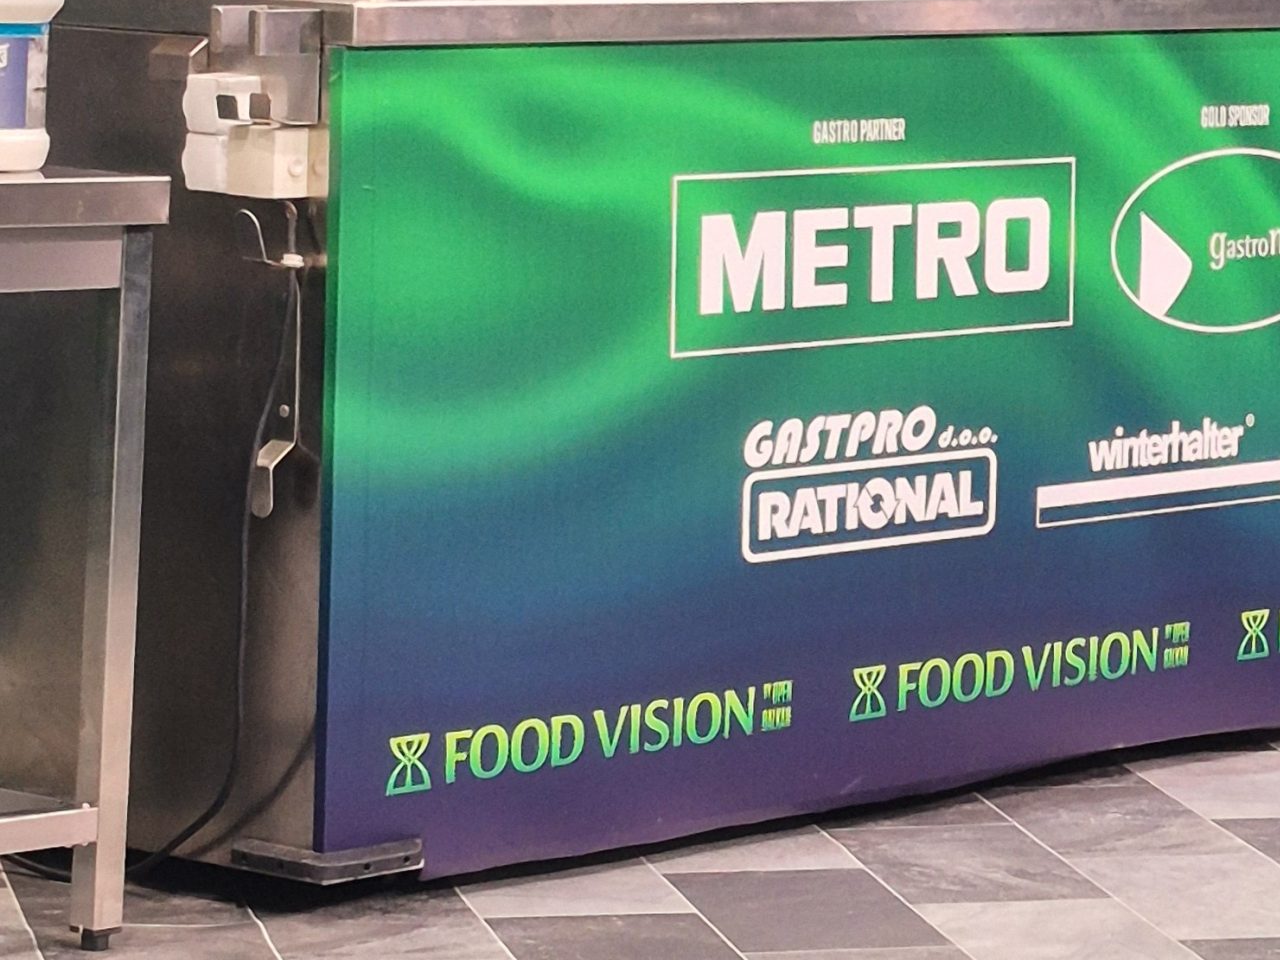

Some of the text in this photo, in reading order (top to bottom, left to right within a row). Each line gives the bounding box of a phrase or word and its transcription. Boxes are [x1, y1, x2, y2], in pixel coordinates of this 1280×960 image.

[813, 118, 906, 144] GASTRO PARTNER
[1201, 104, 1270, 128] GOLD SPONSOR
[700, 197, 1050, 315] METRO
[744, 405, 998, 468] GASTPRO d.o.o.
[1088, 417, 1245, 472] winterhalter
[758, 470, 984, 541] RATIONAL
[896, 627, 1160, 713] FOOD VISION
[445, 686, 757, 784] FOOD VISION
